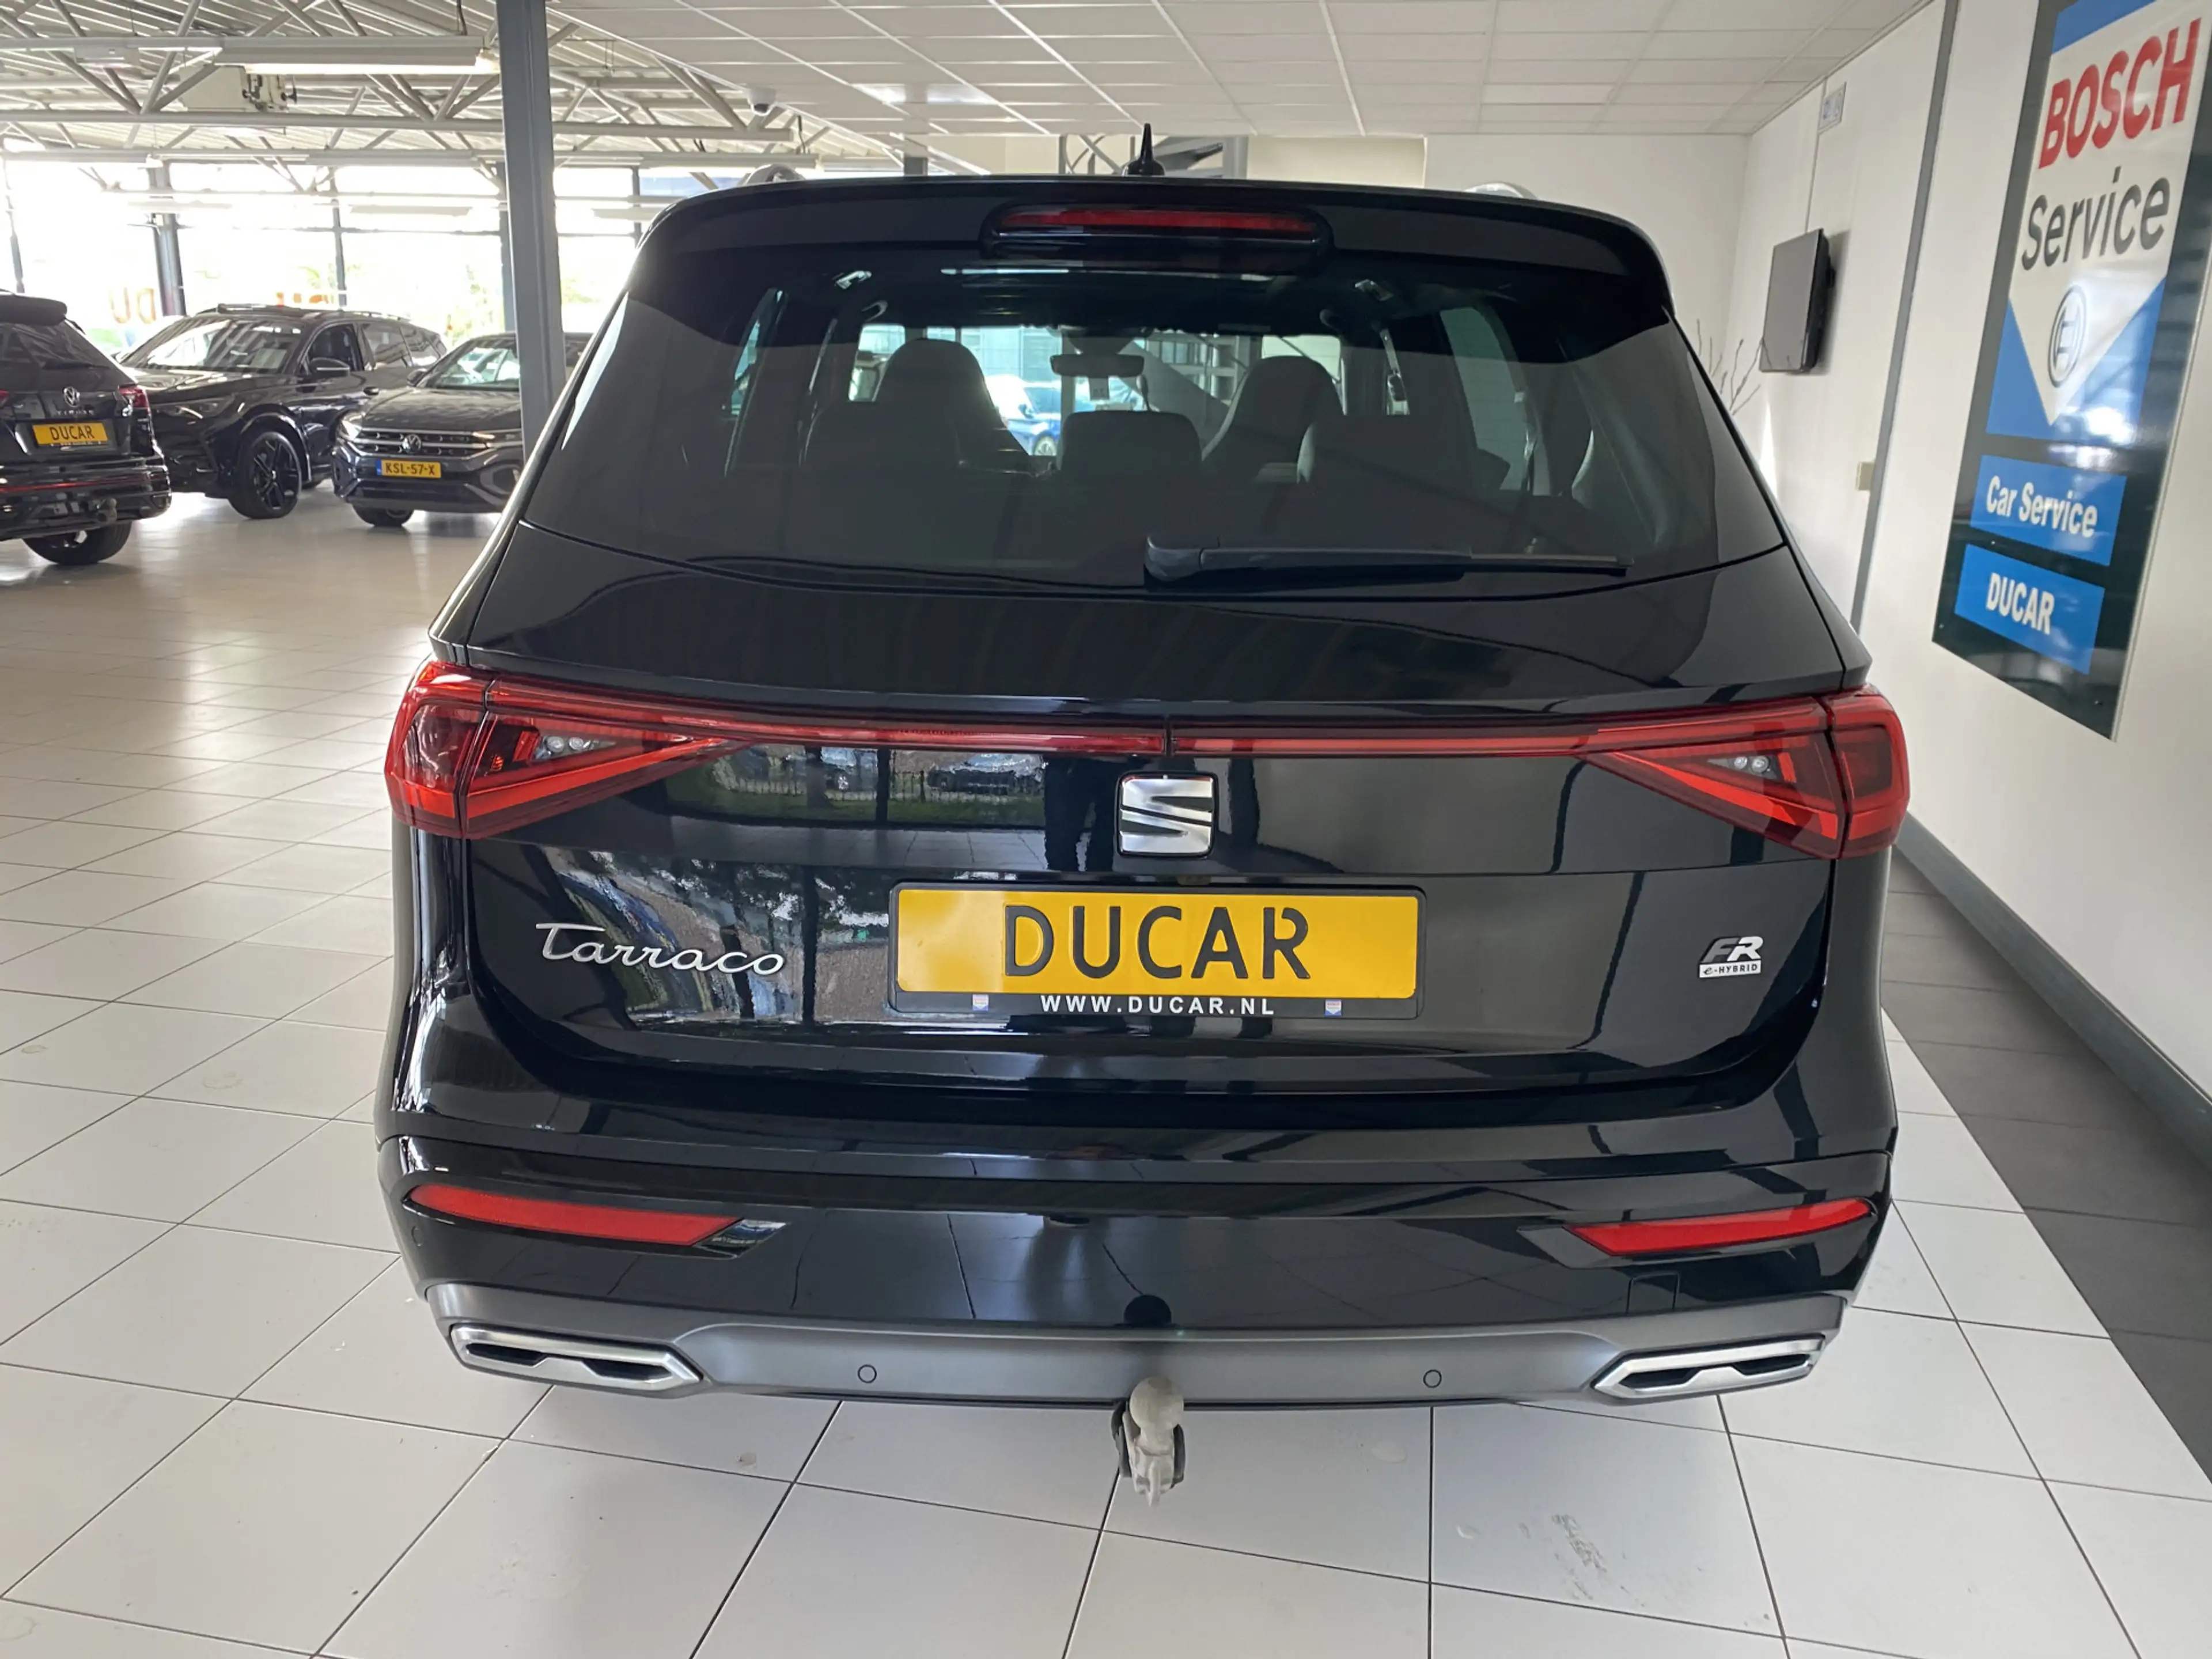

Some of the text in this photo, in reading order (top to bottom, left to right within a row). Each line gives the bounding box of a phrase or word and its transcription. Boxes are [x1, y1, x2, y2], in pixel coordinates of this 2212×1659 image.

[2039, 18, 2201, 169] BOSCH
[2021, 166, 2171, 270] Service
[50, 425, 94, 441] DUCAR
[385, 463, 435, 475] KSL-57-X
[1986, 475, 2098, 538] Car Service
[1986, 573, 2055, 635] DUCAR
[536, 923, 785, 975] Tarraco
[1005, 906, 1310, 979] DUCAR
[1701, 935, 1763, 963] FR
[1703, 964, 1758, 975] e-HYBRID
[1040, 994, 1275, 1016] WWW.DUCAR.NL
